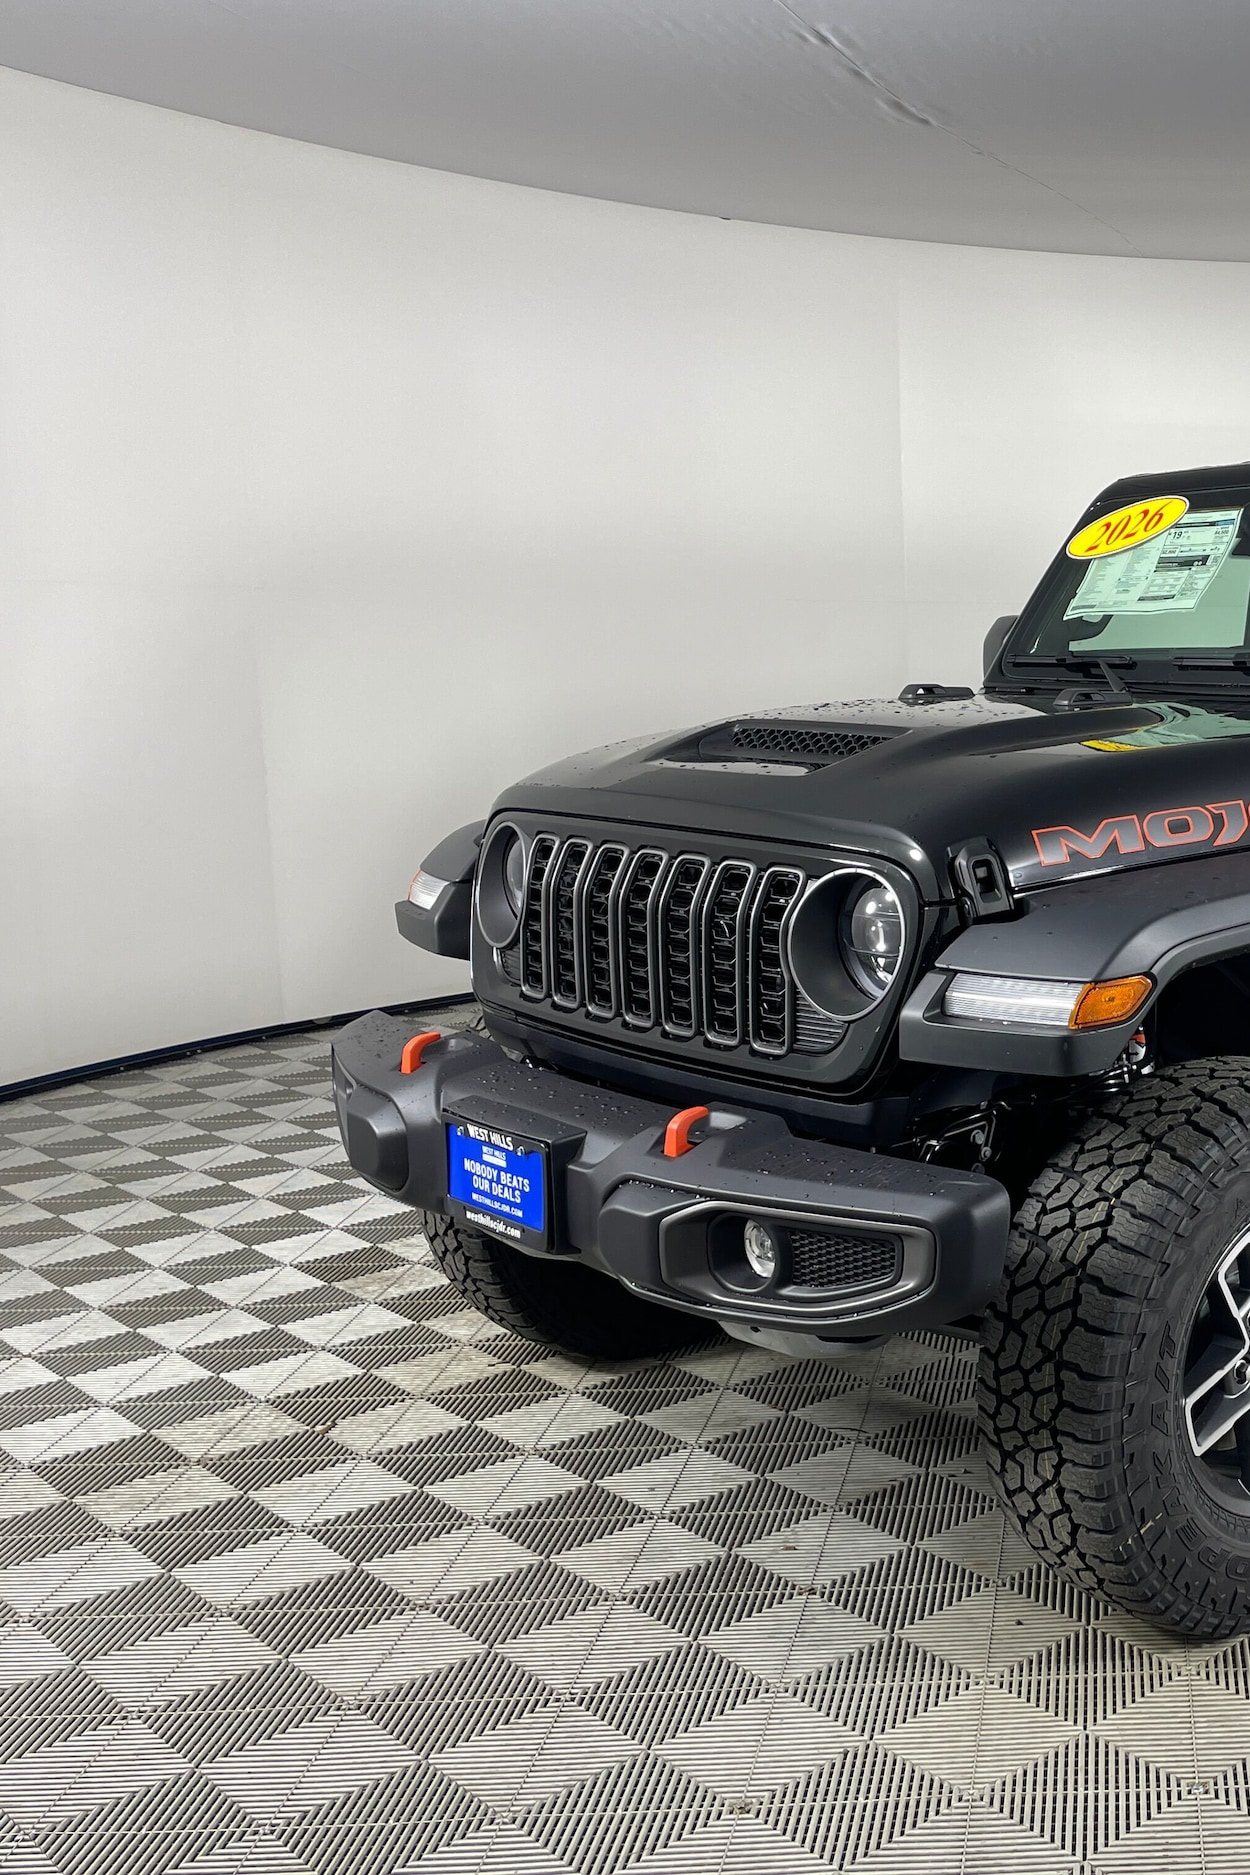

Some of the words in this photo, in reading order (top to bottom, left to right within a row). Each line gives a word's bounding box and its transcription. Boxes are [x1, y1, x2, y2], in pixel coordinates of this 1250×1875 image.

[1084, 500, 1173, 553] 2026
[467, 1123, 489, 1142] WEST
[489, 1131, 514, 1151] HILLS
[464, 1158, 498, 1182] NOBODY
[500, 1170, 530, 1193] BEATS
[472, 1175, 490, 1193] OUR
[491, 1182, 522, 1204] DEALS
[466, 1210, 521, 1239] westhillscjdr.com
